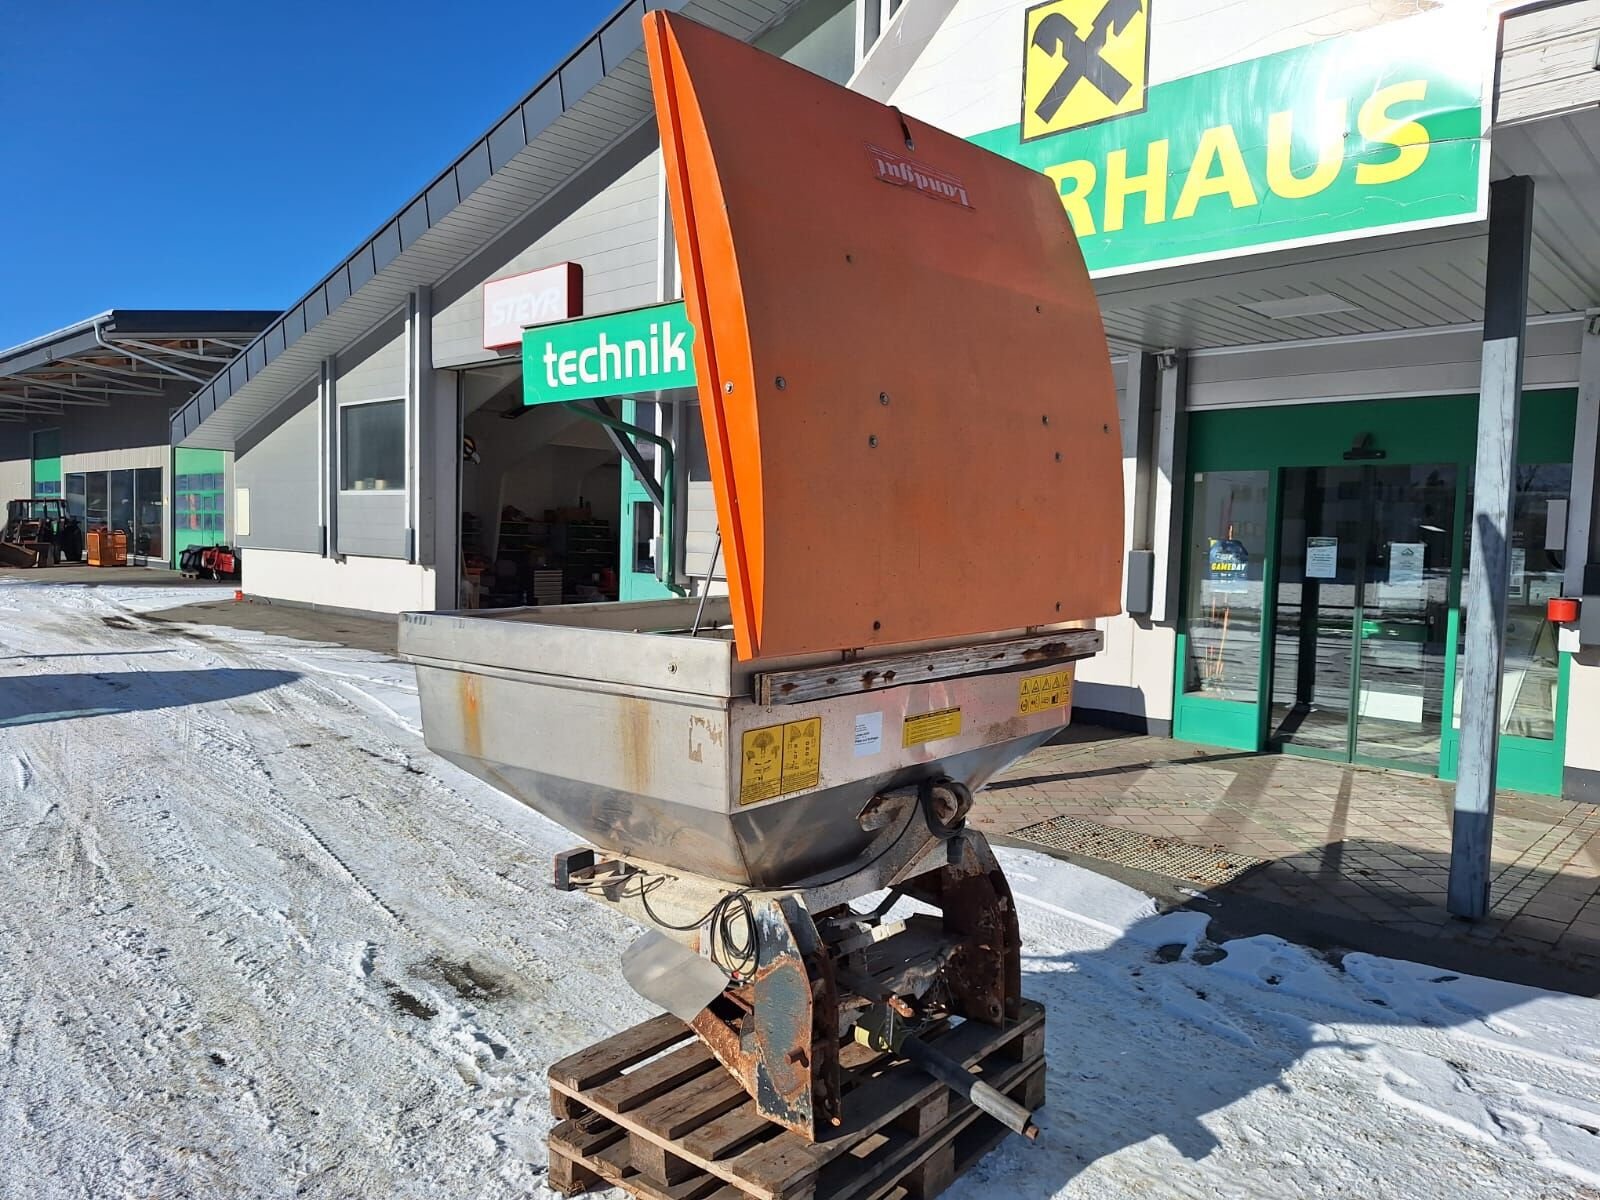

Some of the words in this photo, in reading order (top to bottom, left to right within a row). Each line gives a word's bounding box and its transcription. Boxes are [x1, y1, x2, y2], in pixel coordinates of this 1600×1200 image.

[876, 159, 969, 206] Landgut
[1044, 81, 1430, 238] RHAUS
[491, 288, 561, 326] STEYR
[544, 321, 686, 388] technik
